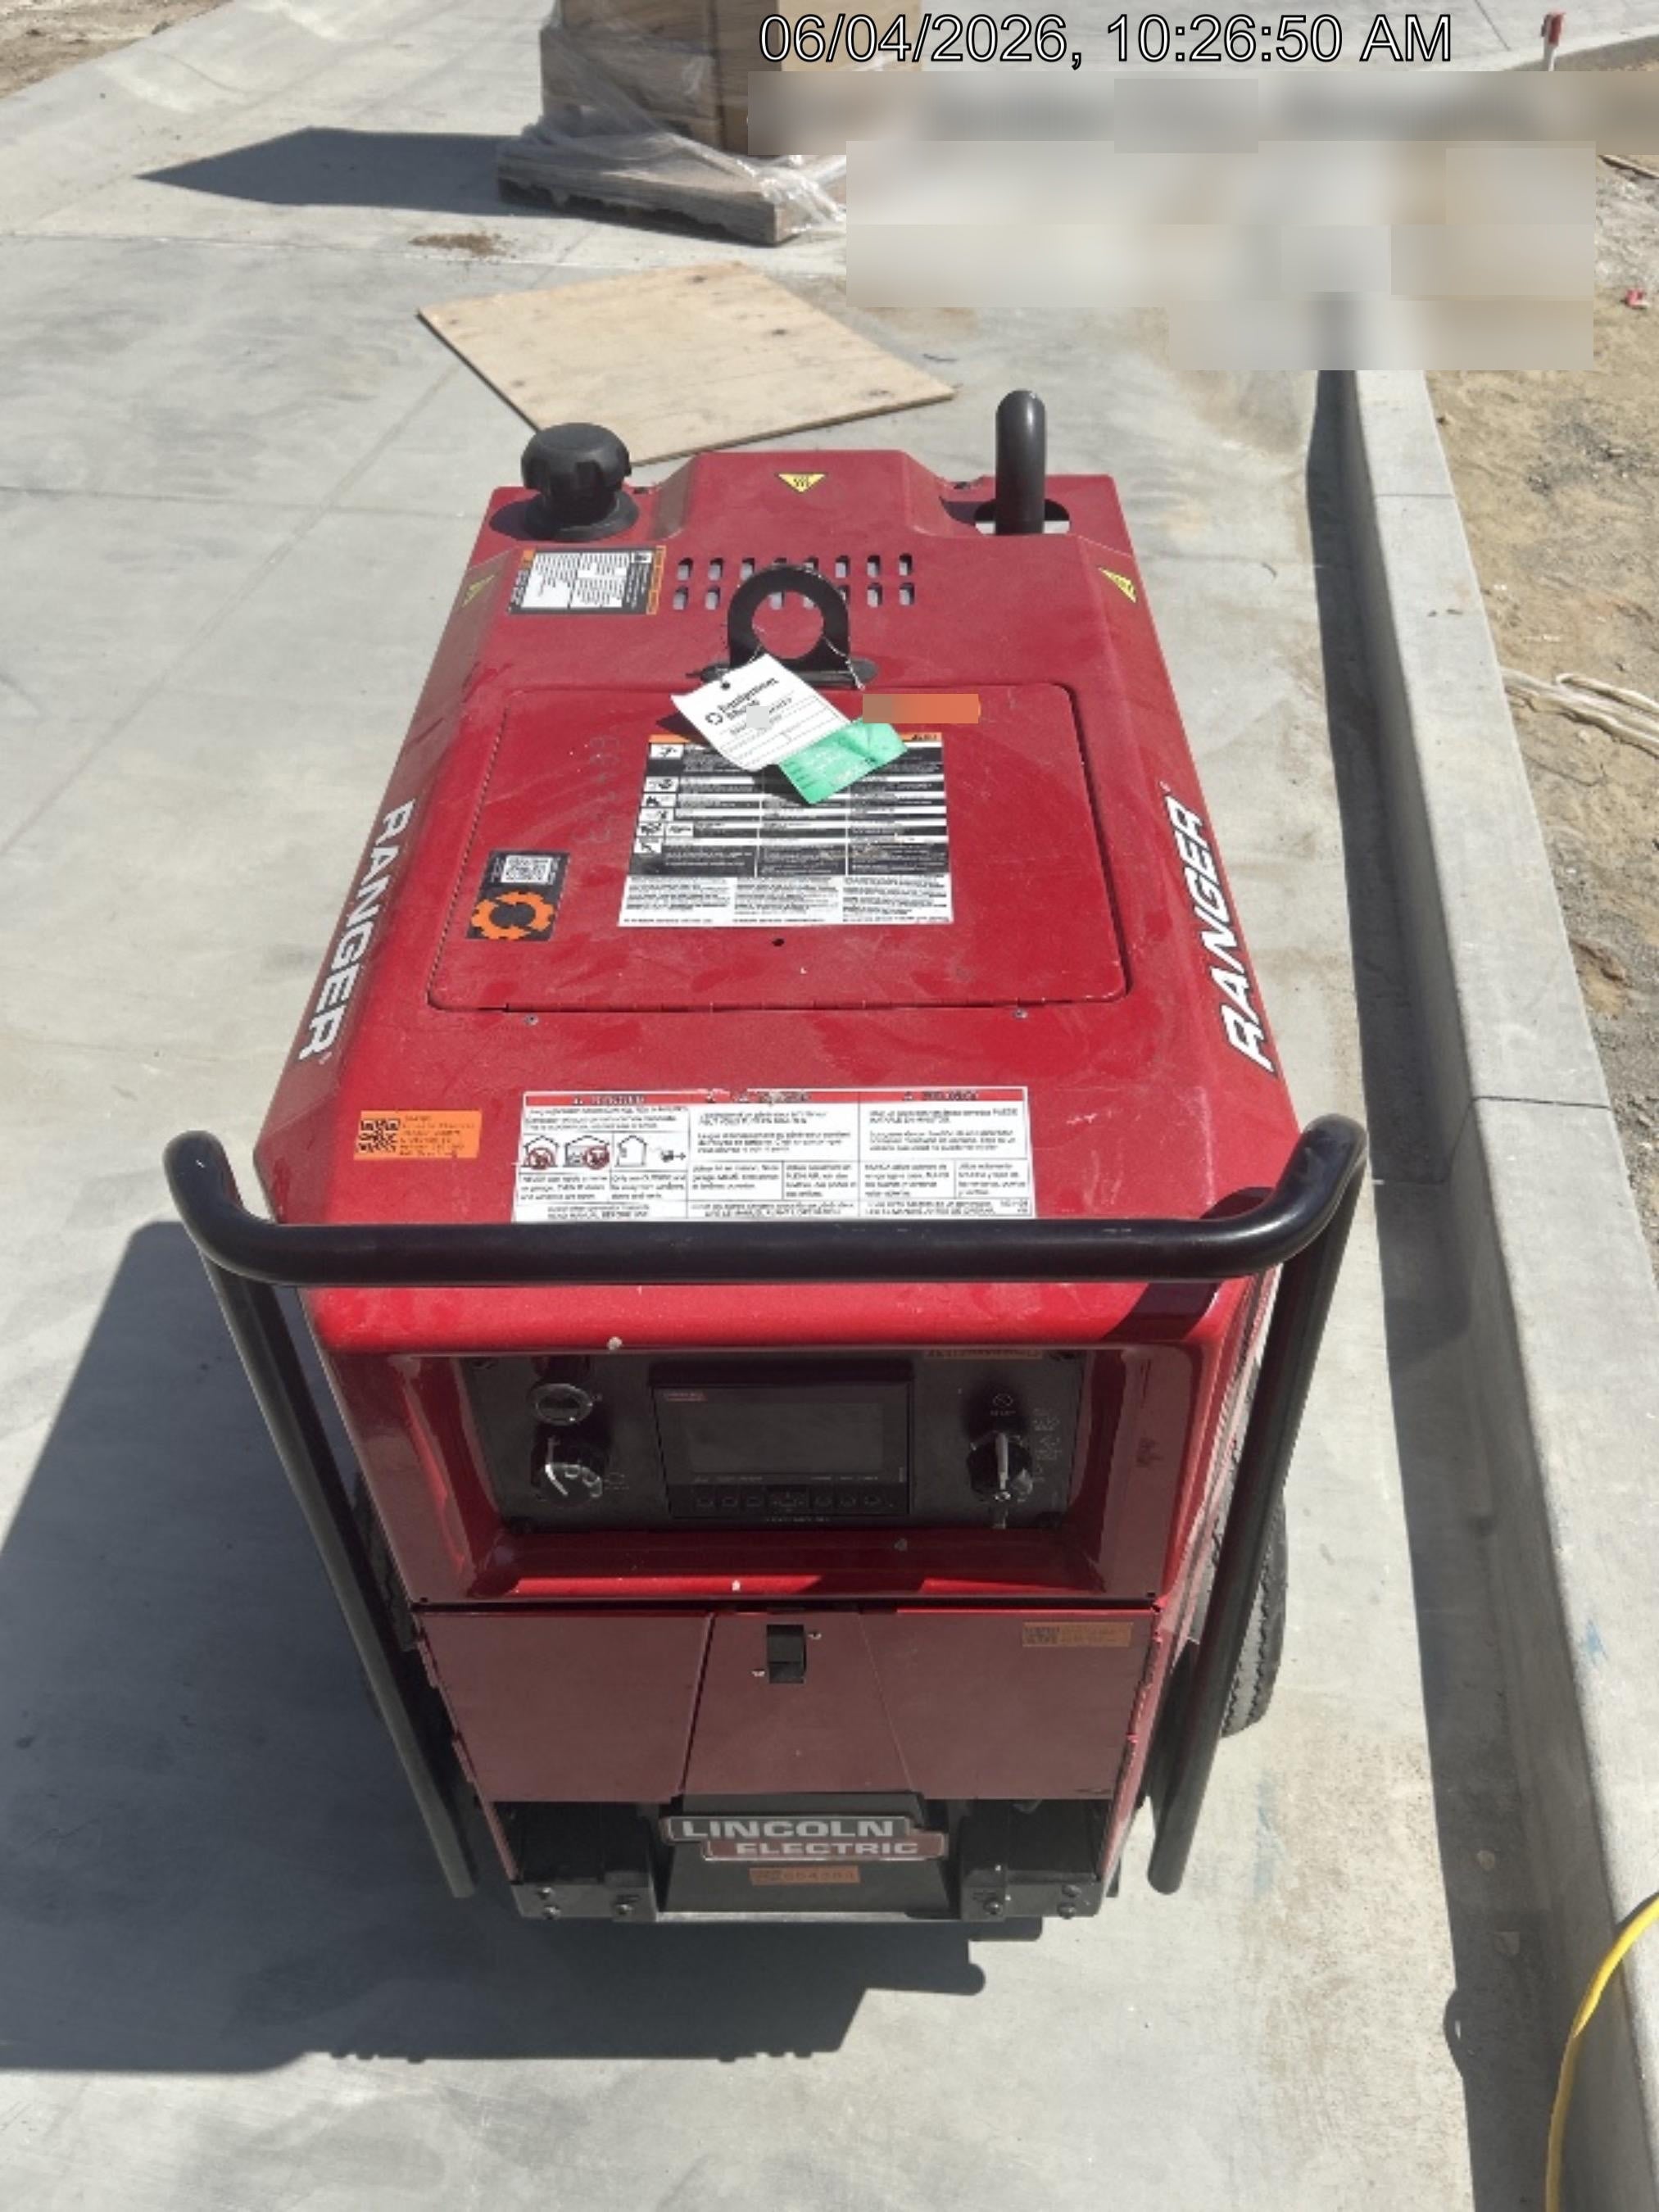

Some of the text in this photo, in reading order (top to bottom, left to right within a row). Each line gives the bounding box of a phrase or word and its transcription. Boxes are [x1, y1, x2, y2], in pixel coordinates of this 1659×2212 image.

[299, 799, 415, 1060] RANGER
[1165, 795, 1276, 1072] RANGER
[681, 1820, 895, 1838] LINCOLN
[736, 1842, 918, 1856] ELECTRIC
